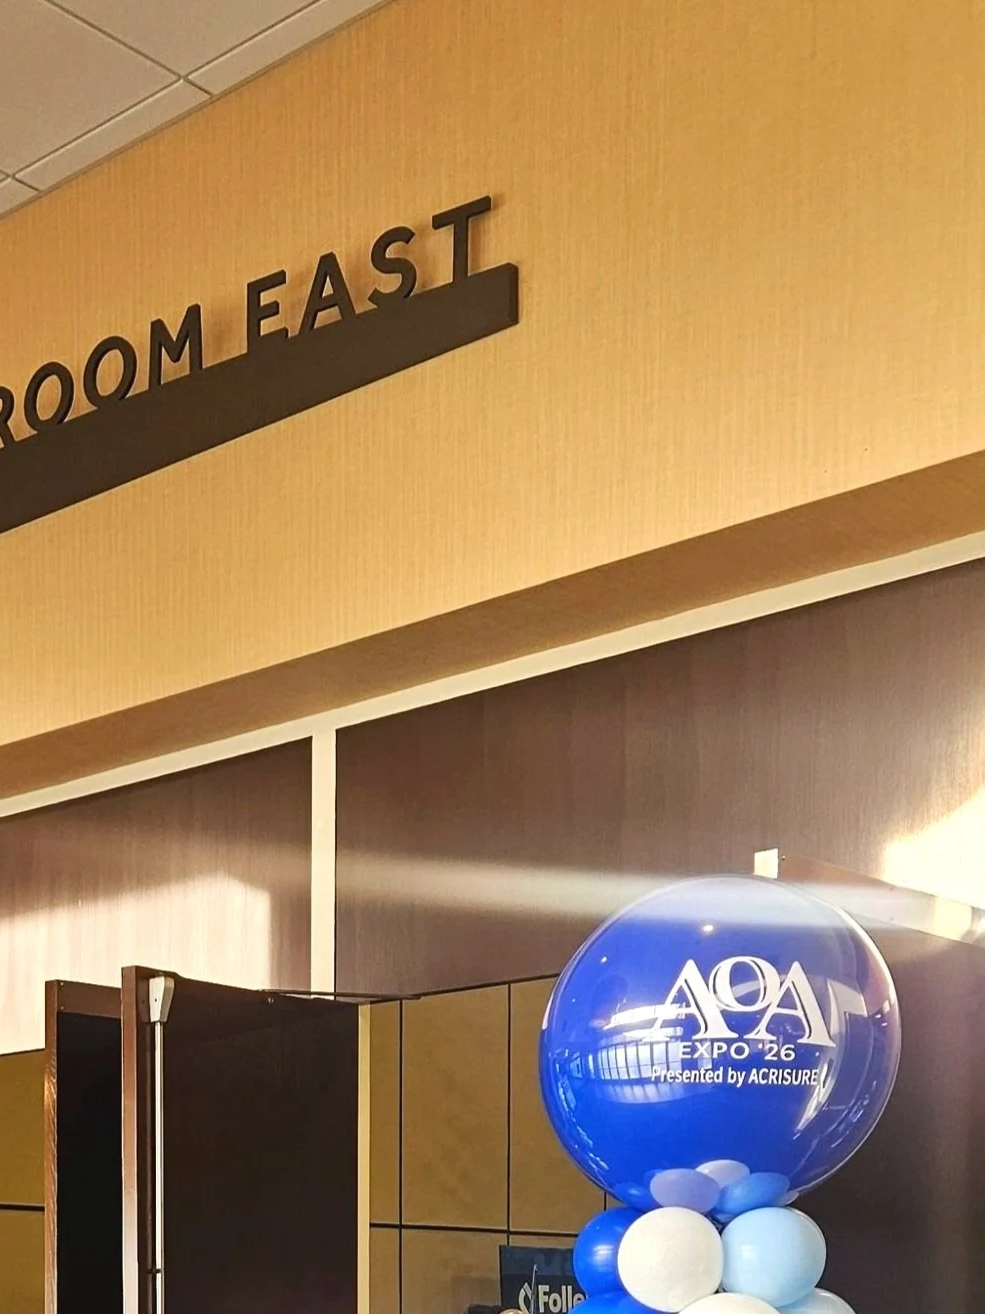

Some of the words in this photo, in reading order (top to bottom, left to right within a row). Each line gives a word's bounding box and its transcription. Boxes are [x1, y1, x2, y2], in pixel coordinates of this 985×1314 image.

[245, 194, 492, 346] EAST
[642, 955, 837, 1048] AOA
[652, 1065, 723, 1084] Presented
[727, 1067, 746, 1088] by
[749, 1068, 819, 1086] ACRISURE
[680, 1042, 750, 1060] EXPO
